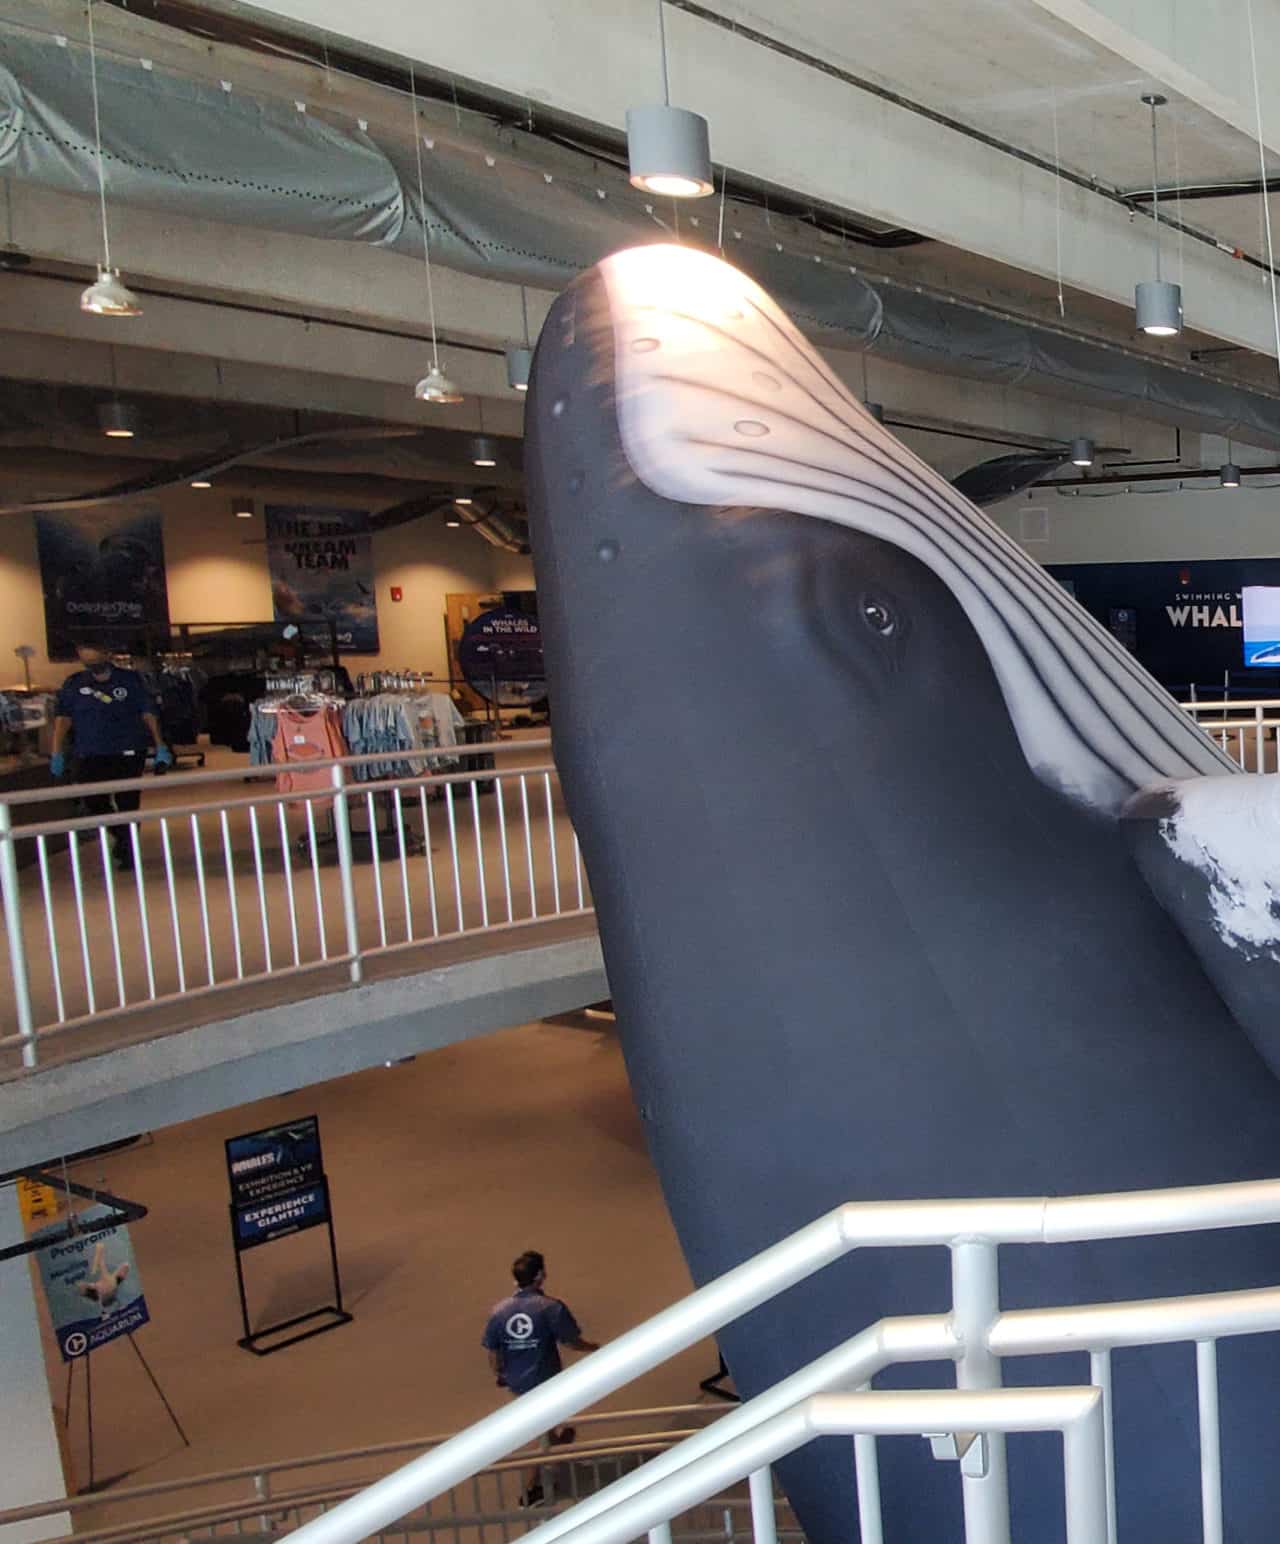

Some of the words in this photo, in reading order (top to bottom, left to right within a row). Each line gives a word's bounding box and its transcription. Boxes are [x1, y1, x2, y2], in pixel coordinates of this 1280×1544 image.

[1175, 592, 1231, 601] SWIMMING
[1165, 605, 1242, 627] WHAL
[244, 1193, 315, 1222] EXPERIENCE
[257, 1206, 305, 1228] GIANTS!
[50, 1226, 118, 1259] Programs
[90, 1311, 143, 1344] AQUARIUM
